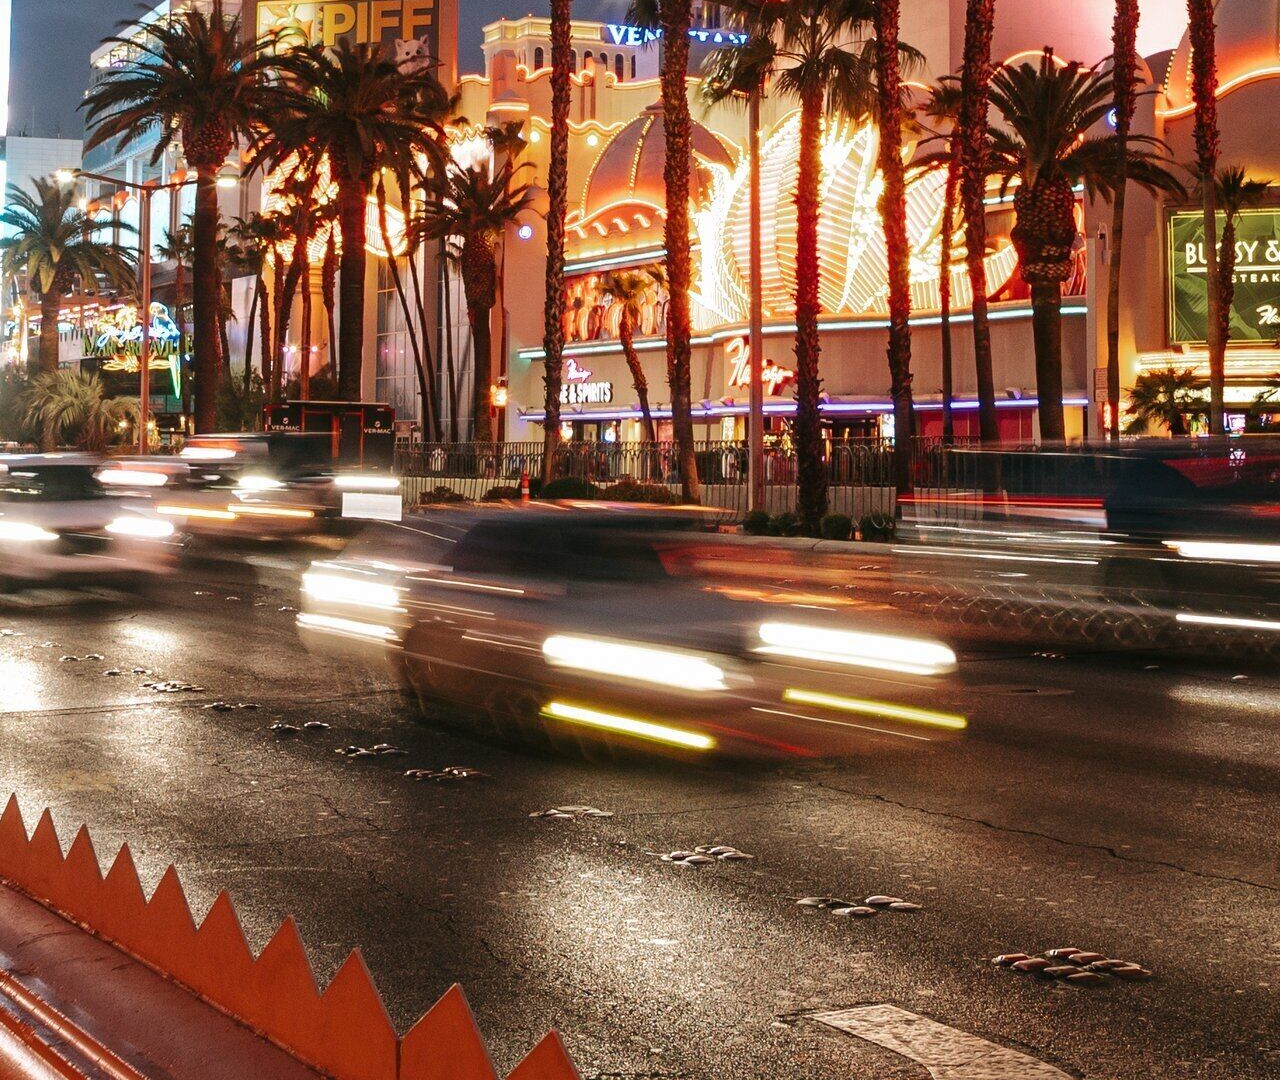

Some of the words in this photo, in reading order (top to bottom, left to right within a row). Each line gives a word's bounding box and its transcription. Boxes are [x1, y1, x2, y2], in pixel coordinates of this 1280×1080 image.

[1185, 240, 1259, 265] BUSY
[577, 381, 612, 404] SPIRITS
[271, 424, 301, 432] VER-MAC
[363, 427, 392, 435] VER-MAC
